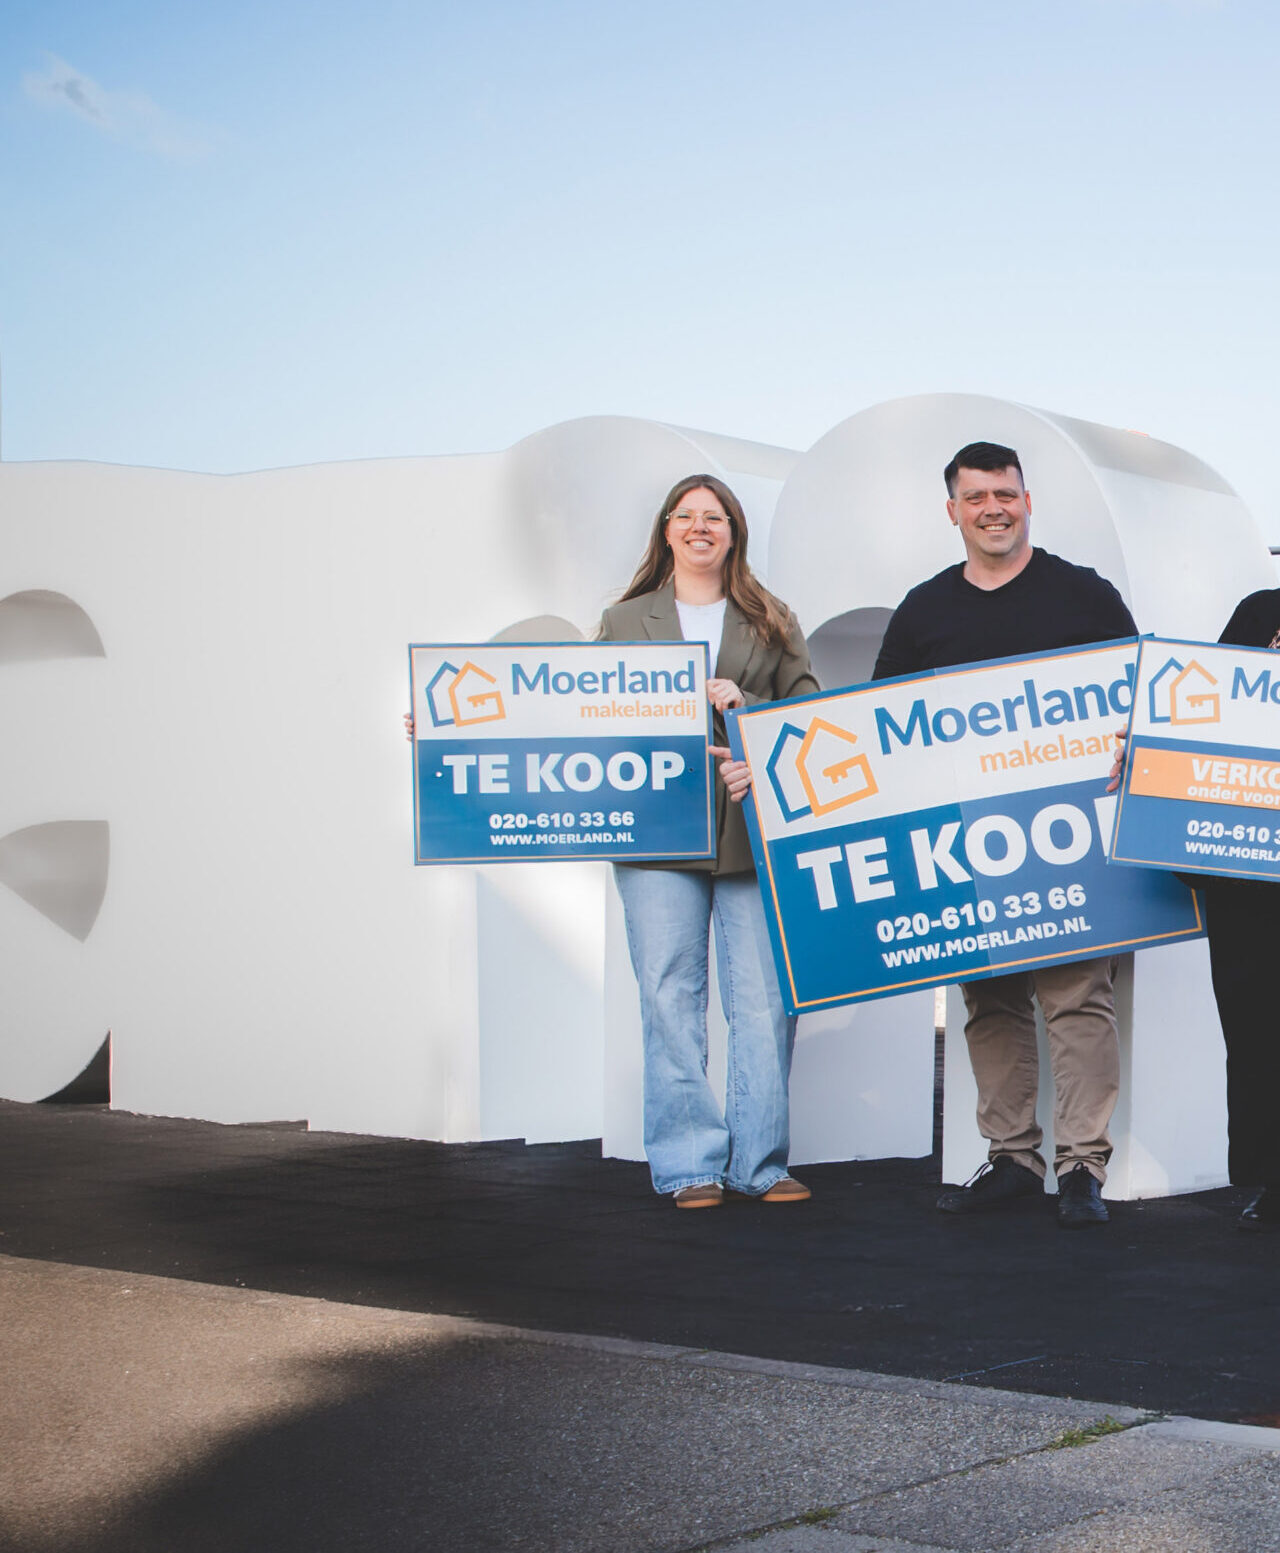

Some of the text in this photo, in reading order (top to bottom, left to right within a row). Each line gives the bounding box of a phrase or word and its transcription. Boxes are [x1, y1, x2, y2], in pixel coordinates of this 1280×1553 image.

[512, 660, 695, 695] Moerland
[580, 699, 697, 720] makelaardij
[874, 663, 1135, 756] Moerland
[980, 723, 1127, 773] makelaar
[442, 751, 686, 795] TE KOOP
[1187, 784, 1239, 803] onder
[489, 811, 634, 829] 020-610 33 66
[490, 832, 635, 845] WWW.MOERLAND.NL
[1187, 820, 1269, 843] 020-610
[796, 836, 896, 911] TE
[877, 884, 1087, 943] 020-610 33 66
[881, 916, 1091, 969] WWW.MOERLAND.NL
